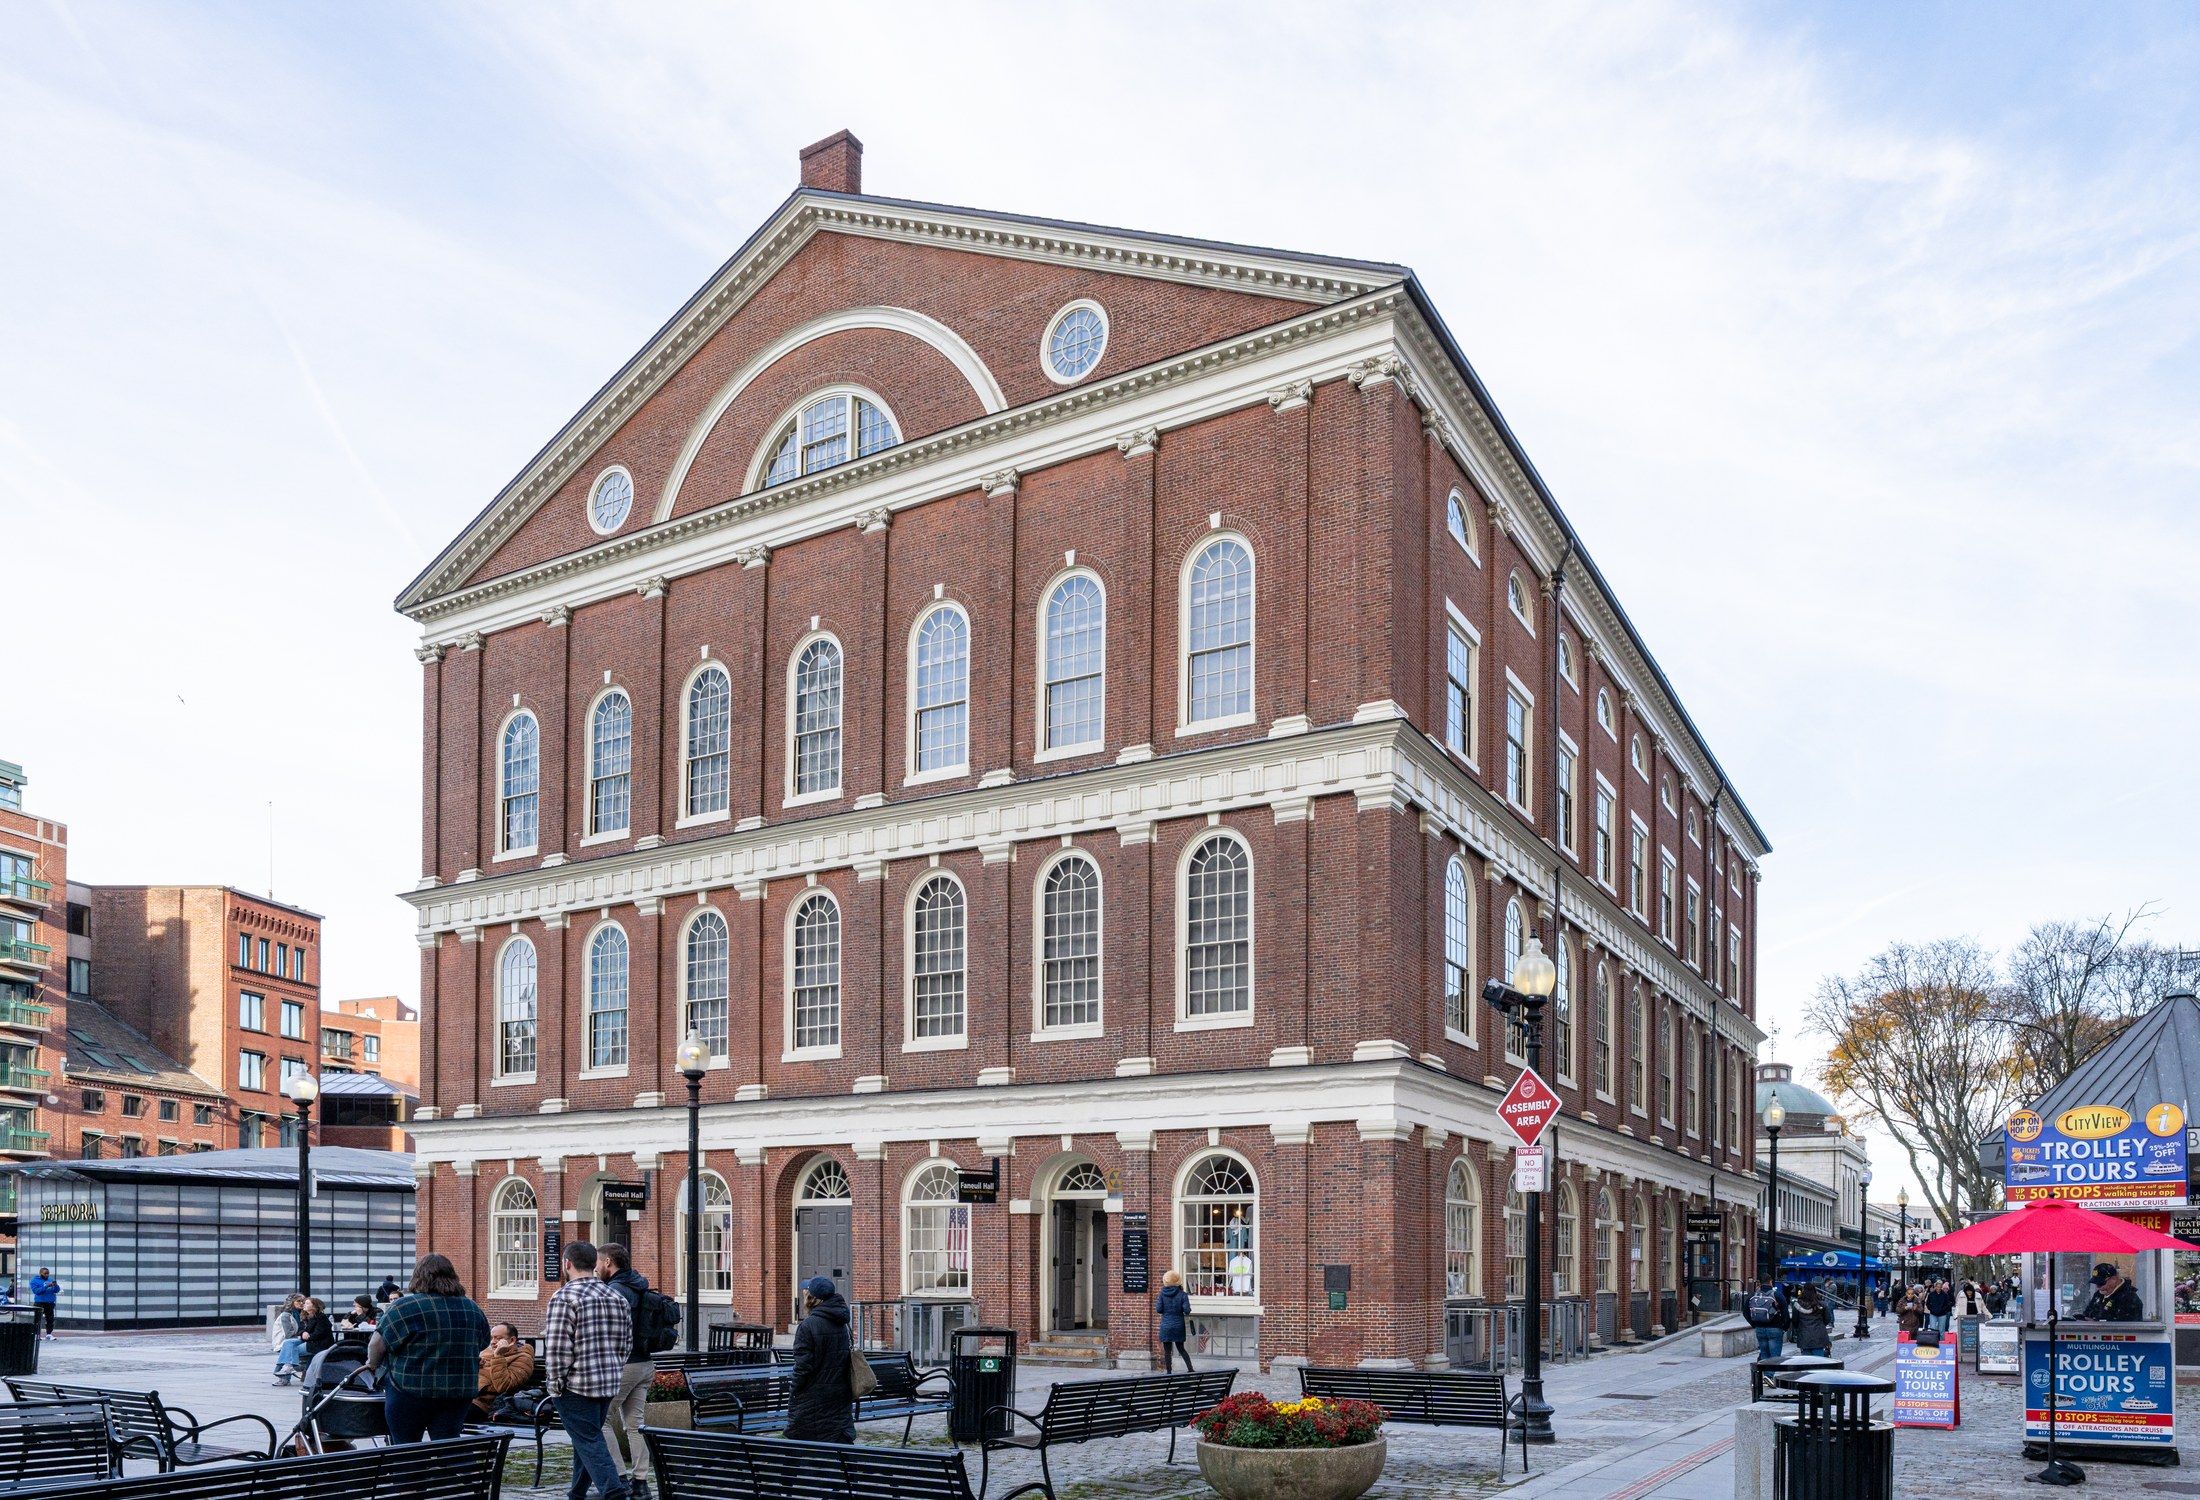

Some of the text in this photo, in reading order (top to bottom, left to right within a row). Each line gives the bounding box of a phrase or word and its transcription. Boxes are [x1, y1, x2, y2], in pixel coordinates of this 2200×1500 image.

[1505, 1100, 1551, 1114] ASSEMBLY
[1516, 1115, 1541, 1127] AREA
[2010, 1117, 2039, 1126] HOP ON
[2041, 1138, 2149, 1161] TROLLEY
[2154, 1149, 2176, 1158] OFF!
[2053, 1162, 2138, 1182] TOURS
[2029, 1186, 2101, 1199] 50 STOPS
[41, 1203, 98, 1221] SEPHORA
[2067, 1343, 2120, 1351] MULTILINGUAL
[2045, 1353, 2145, 1373] TROLLEY
[1900, 1370, 1951, 1380] TROLLEY
[1904, 1380, 1945, 1391] TOURS
[2056, 1374, 2135, 1393] TOURS
[2065, 1413, 2098, 1422] STOPS
